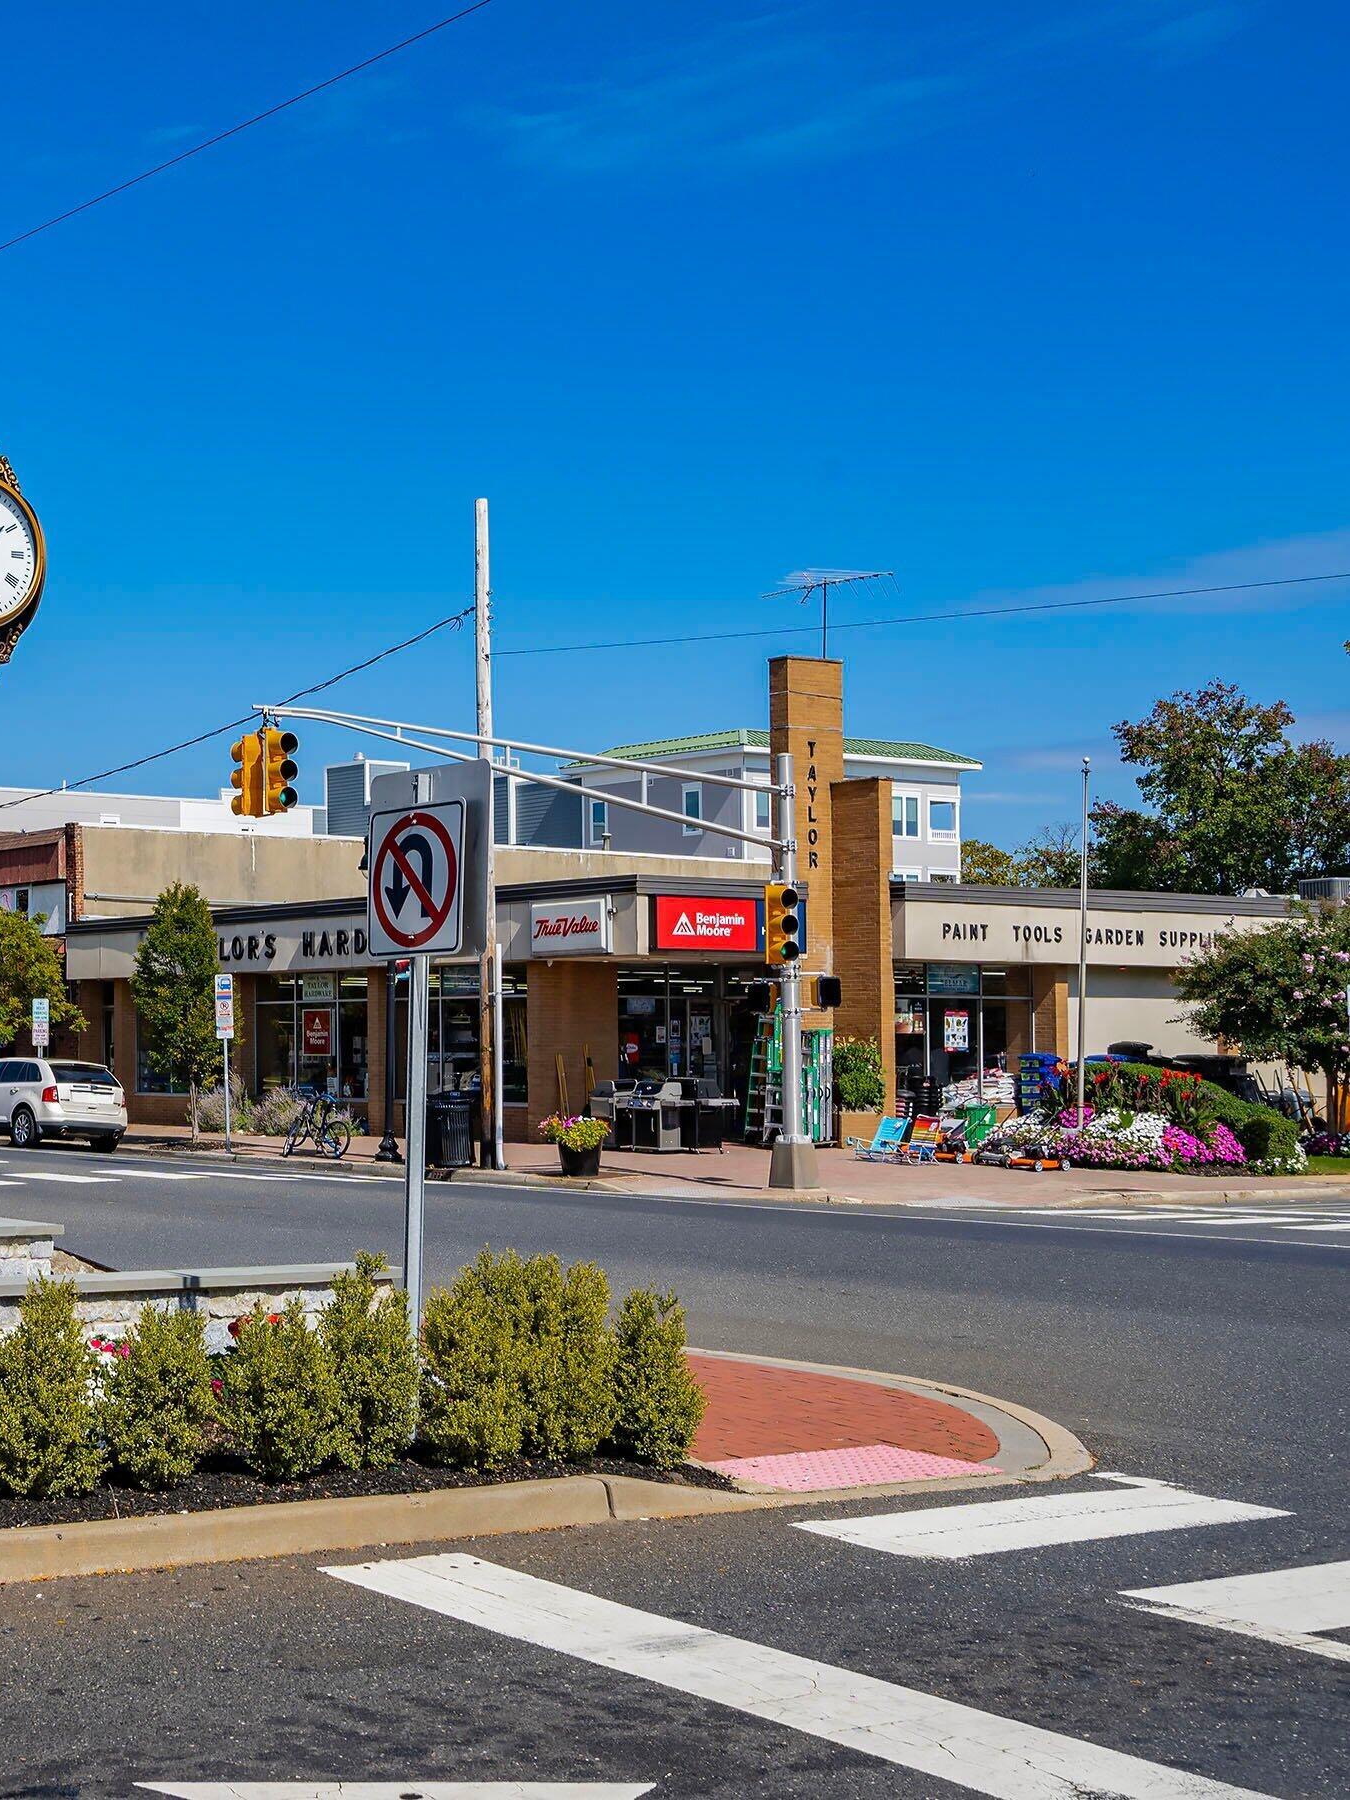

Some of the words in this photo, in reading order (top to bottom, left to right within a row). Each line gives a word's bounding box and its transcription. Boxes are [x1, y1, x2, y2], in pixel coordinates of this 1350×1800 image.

[807, 741, 818, 869] TAYLOR
[696, 911, 745, 928] Benjamin
[696, 925, 731, 937] Moore
[942, 922, 989, 941] PAINT
[1012, 925, 1062, 943] TOOLS
[1085, 928, 1144, 946] GARDEN
[1159, 930, 1218, 948] SUPPLI
[302, 928, 369, 957] HARD
[306, 1030, 329, 1039] Benjamin
[310, 1037, 325, 1045] Moore
